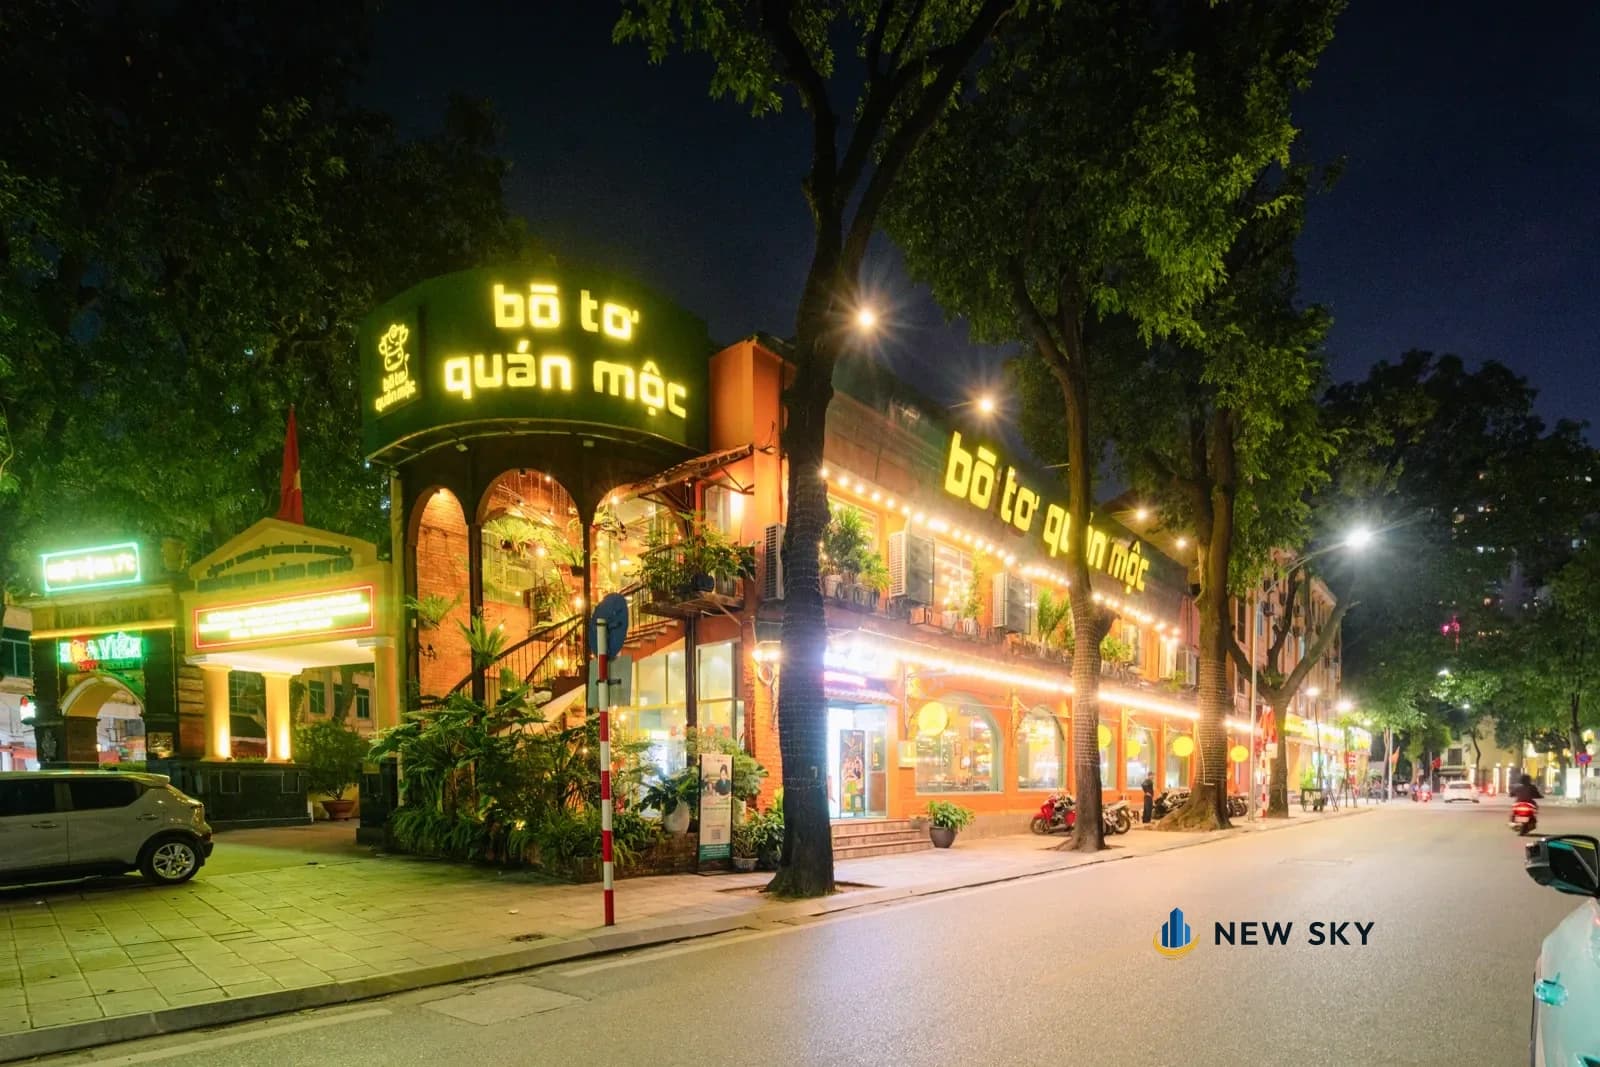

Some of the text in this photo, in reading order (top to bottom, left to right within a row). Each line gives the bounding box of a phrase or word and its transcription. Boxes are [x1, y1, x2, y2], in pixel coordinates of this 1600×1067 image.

[581, 289, 639, 340] tơ
[444, 340, 687, 418] quán mộc
[1001, 466, 1040, 531] tơ
[1107, 540, 1149, 594] mộc
